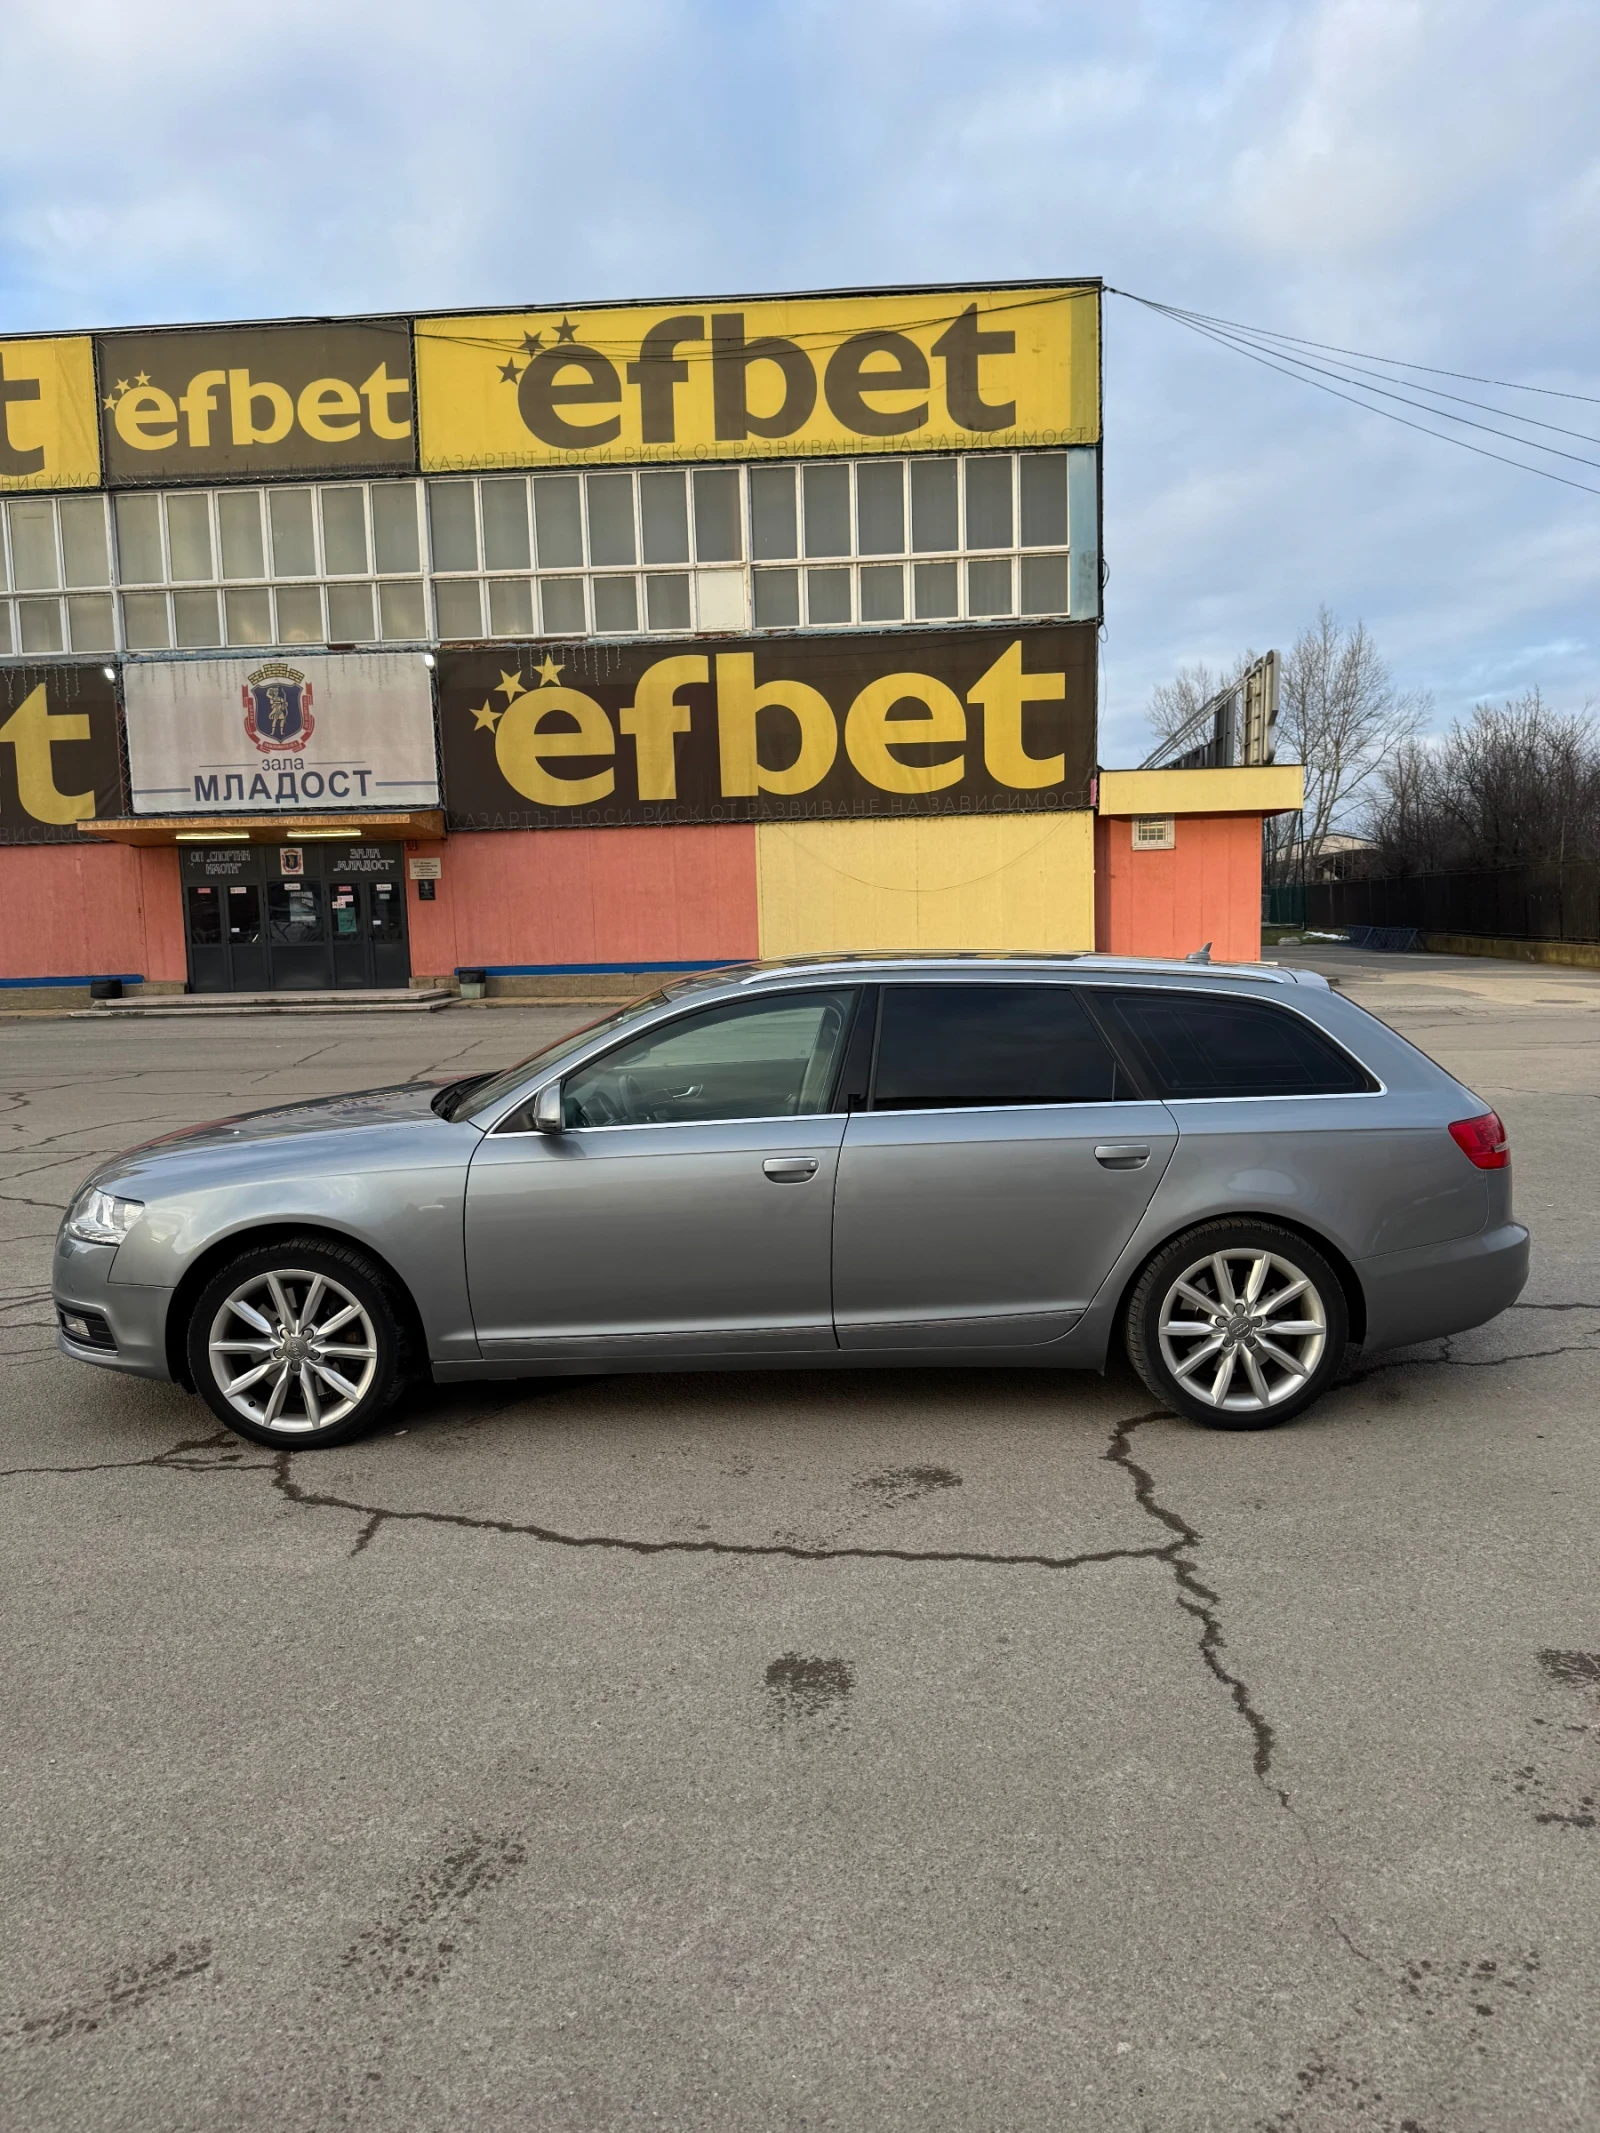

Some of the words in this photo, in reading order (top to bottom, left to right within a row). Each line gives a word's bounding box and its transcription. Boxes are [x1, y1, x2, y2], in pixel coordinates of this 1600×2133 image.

[517, 302, 1017, 449] efbet
[114, 362, 411, 450] efbet
[425, 450, 537, 472] ХАЗАРТЪТ
[549, 447, 613, 467] НОСИ
[624, 443, 684, 464] РИСК
[694, 442, 722, 461] ОТ
[733, 436, 870, 458] РАЗВИВАНЕ
[883, 434, 912, 452] НА
[494, 640, 1066, 807] efbet
[261, 756, 304, 771] зала
[194, 769, 373, 803] МЛАДОСТ
[452, 809, 560, 828] ХАЗАРТЪТ
[571, 808, 631, 825] НОСИ
[644, 805, 698, 821] РИСК
[711, 803, 737, 819] ОТ
[751, 798, 880, 818] РАЗВИВАНЕ
[891, 796, 920, 812] НА
[931, 790, 1088, 811] ЗАВИСИМОСТ
